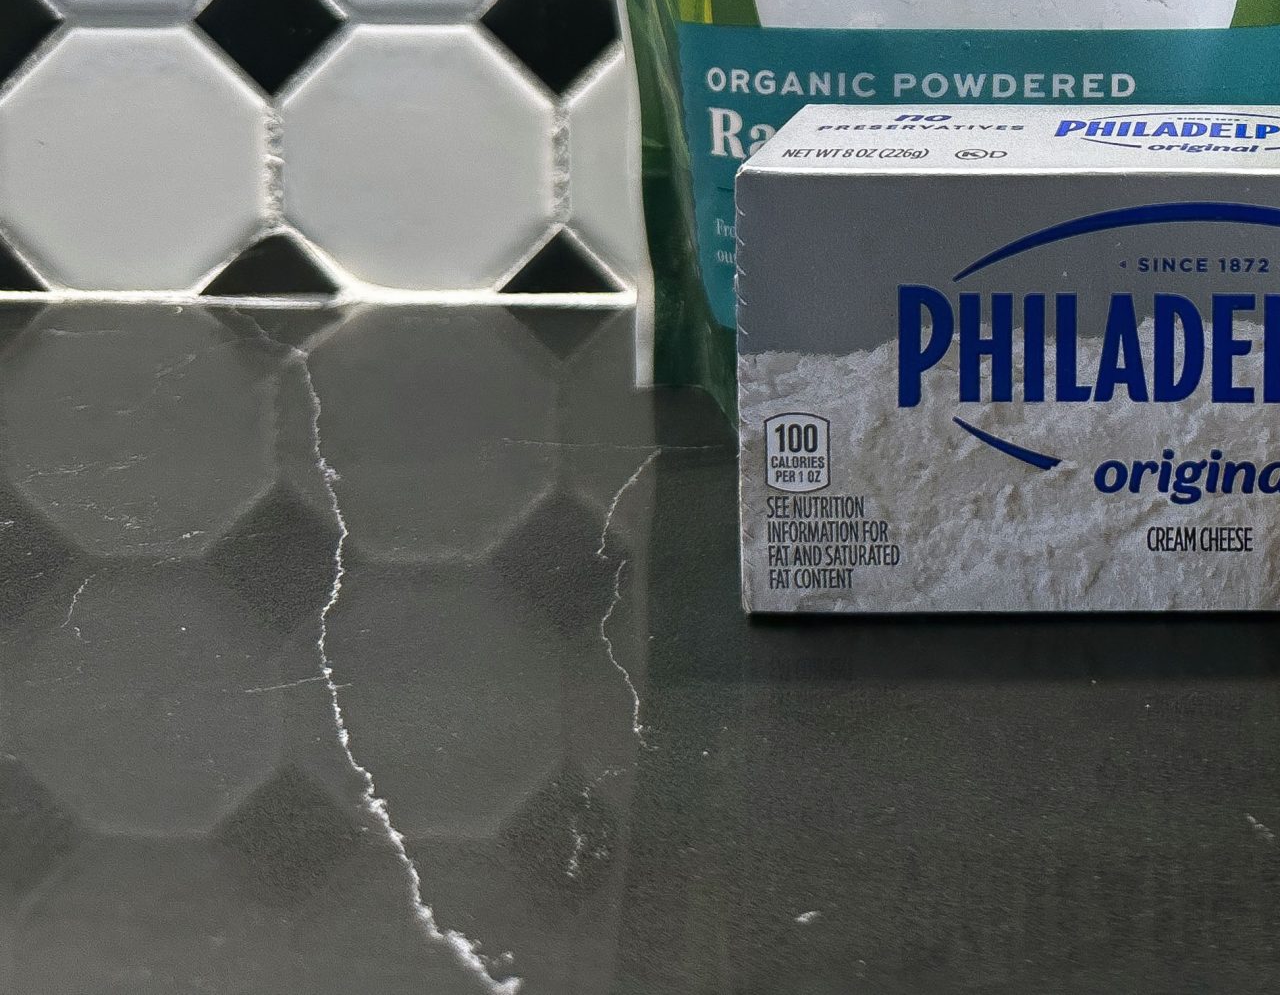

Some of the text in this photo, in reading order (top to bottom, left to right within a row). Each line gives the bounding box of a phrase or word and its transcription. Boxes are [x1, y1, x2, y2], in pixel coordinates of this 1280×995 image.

[707, 66, 1136, 99] ORGANIC POWDERED
[894, 114, 952, 122] no
[708, 106, 777, 159] Ra
[782, 148, 930, 159] NET WT 8 OZ (226g)
[1148, 143, 1259, 153] original
[716, 218, 737, 237] Fro
[1138, 257, 1270, 273] SINCE 1872
[775, 423, 818, 453] 100
[771, 456, 825, 469] CALORIES
[775, 470, 821, 483] PER 1 OZ
[767, 496, 865, 519] SEE NUTRITION
[767, 521, 889, 543] INFORMATION FOR
[1147, 526, 1253, 552] CREAM CHEESE
[768, 544, 900, 567] FAT AND SATURATED
[769, 568, 854, 589] FAT CONTENT
